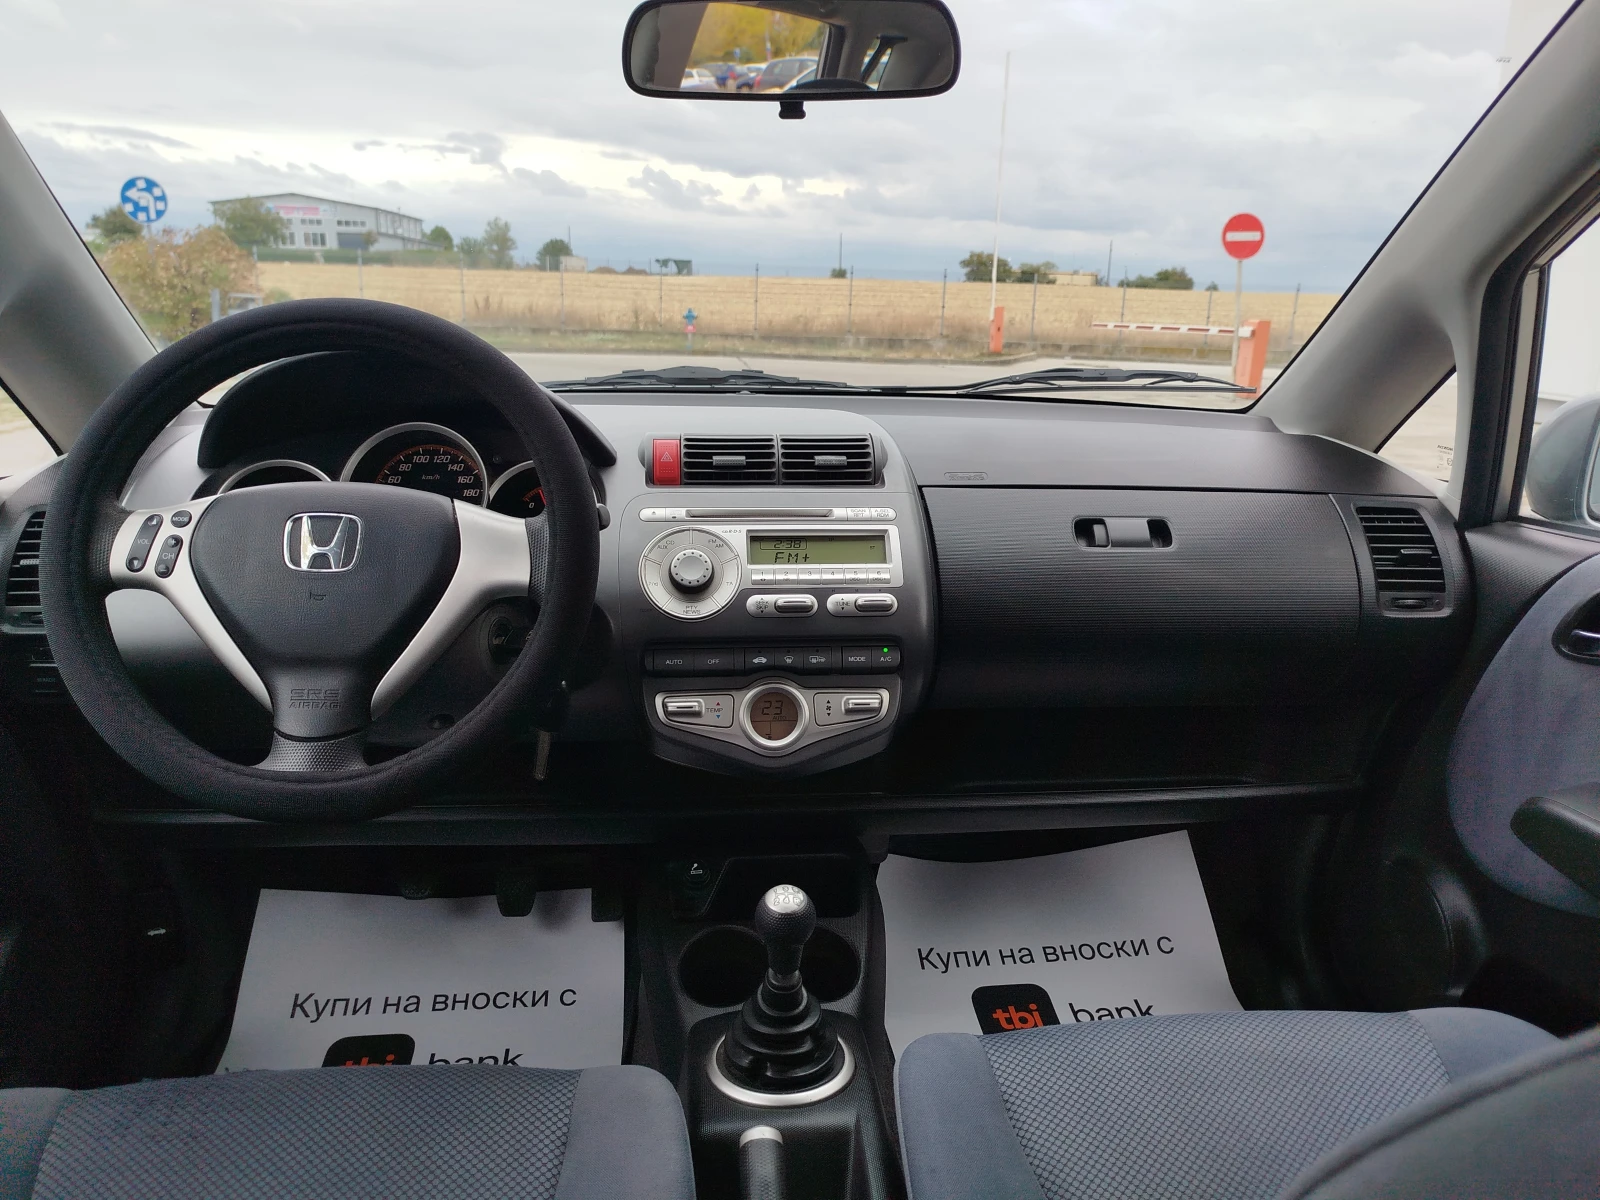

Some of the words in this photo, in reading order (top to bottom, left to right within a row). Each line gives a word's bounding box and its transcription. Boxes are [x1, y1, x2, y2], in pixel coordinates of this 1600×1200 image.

[413, 455, 430, 463] 100
[433, 455, 451, 463] 120
[398, 463, 412, 471] 80
[447, 463, 464, 472] 140
[387, 475, 402, 484] 60
[457, 475, 474, 484] 160
[462, 489, 480, 497] 180
[773, 539, 802, 549] 2:38
[162, 552, 175, 560] CH
[774, 551, 810, 564] FM+
[290, 688, 340, 699] SRS
[289, 701, 341, 710] AIRBAG
[761, 700, 783, 715] 23
[917, 946, 991, 974] Купи
[999, 946, 1035, 966] на
[1043, 936, 1150, 963] вноски
[1156, 935, 1175, 954] с
[289, 992, 372, 1023] Купи
[382, 996, 421, 1014] на
[431, 988, 550, 1012] вноски
[559, 988, 578, 1006] с
[992, 1003, 1044, 1030] tbi
